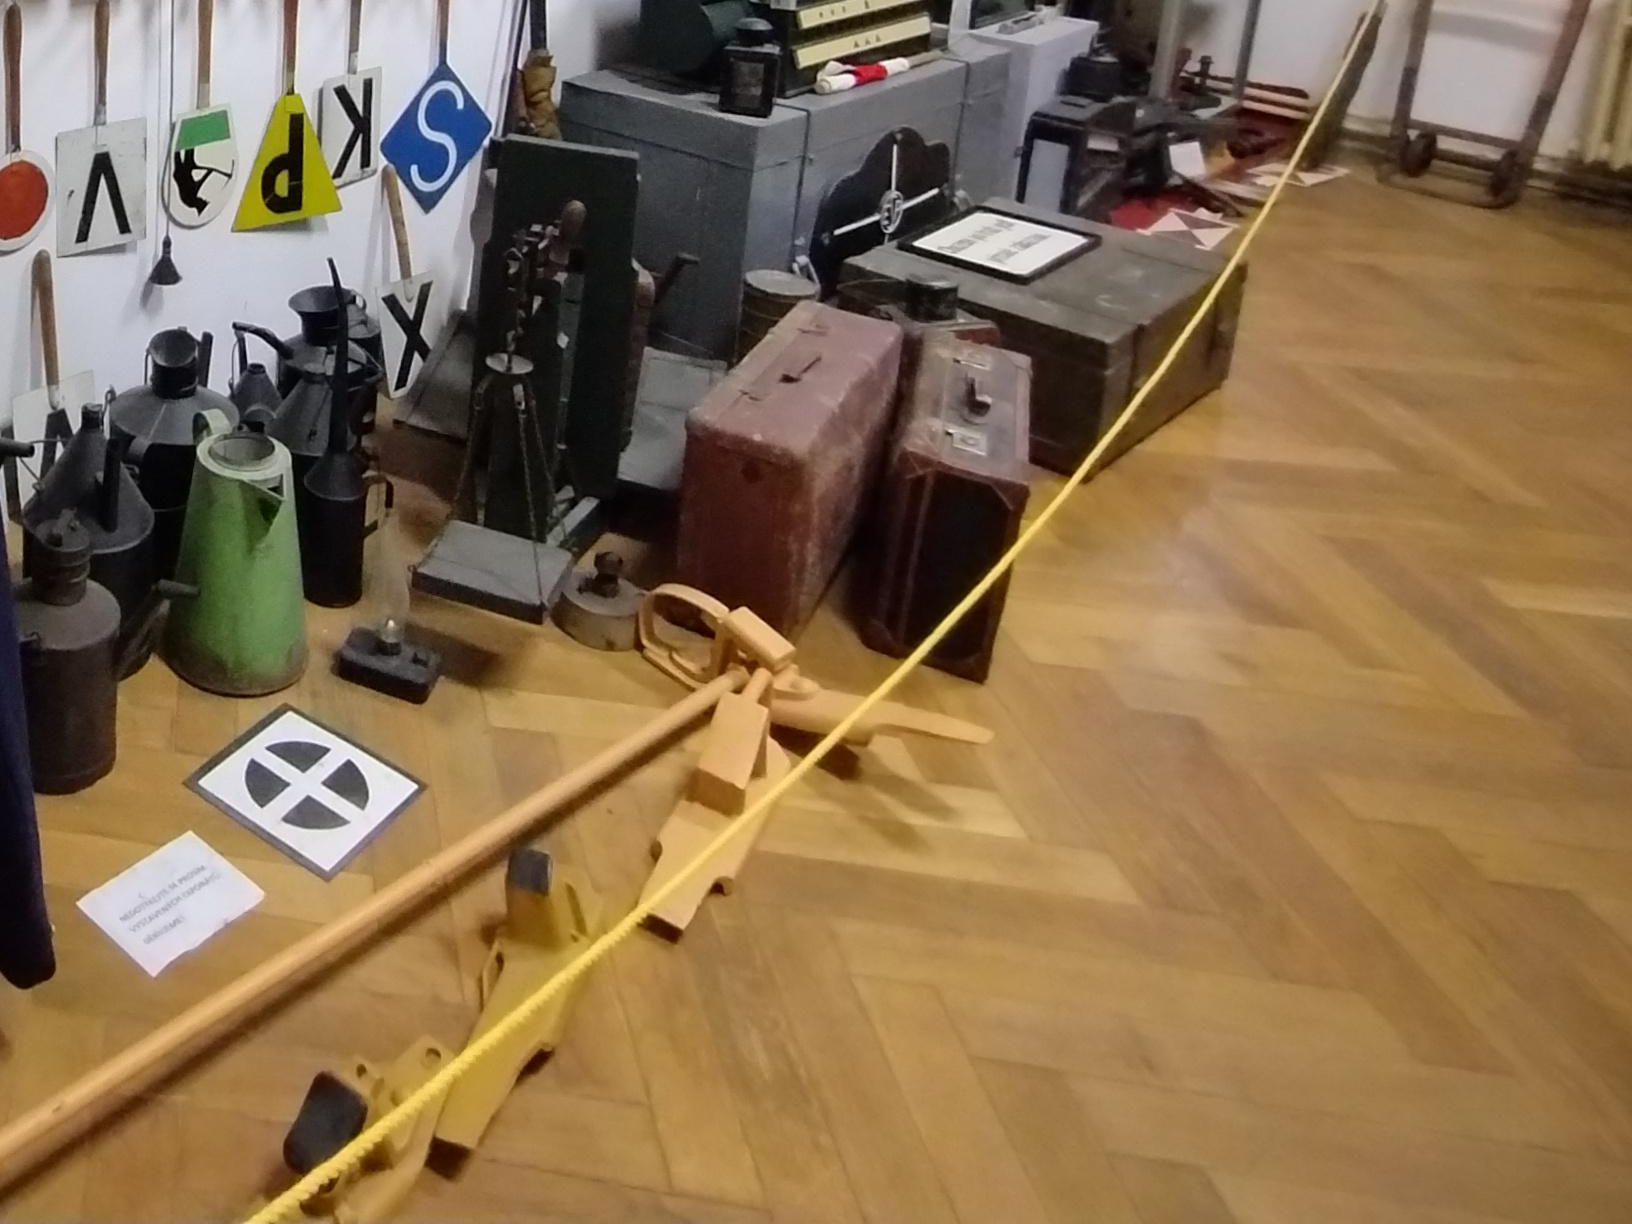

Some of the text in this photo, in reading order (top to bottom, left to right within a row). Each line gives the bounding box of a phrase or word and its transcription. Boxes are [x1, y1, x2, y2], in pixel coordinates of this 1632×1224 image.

[333, 77, 373, 179] K
[409, 80, 465, 193] S
[381, 280, 434, 392] X
